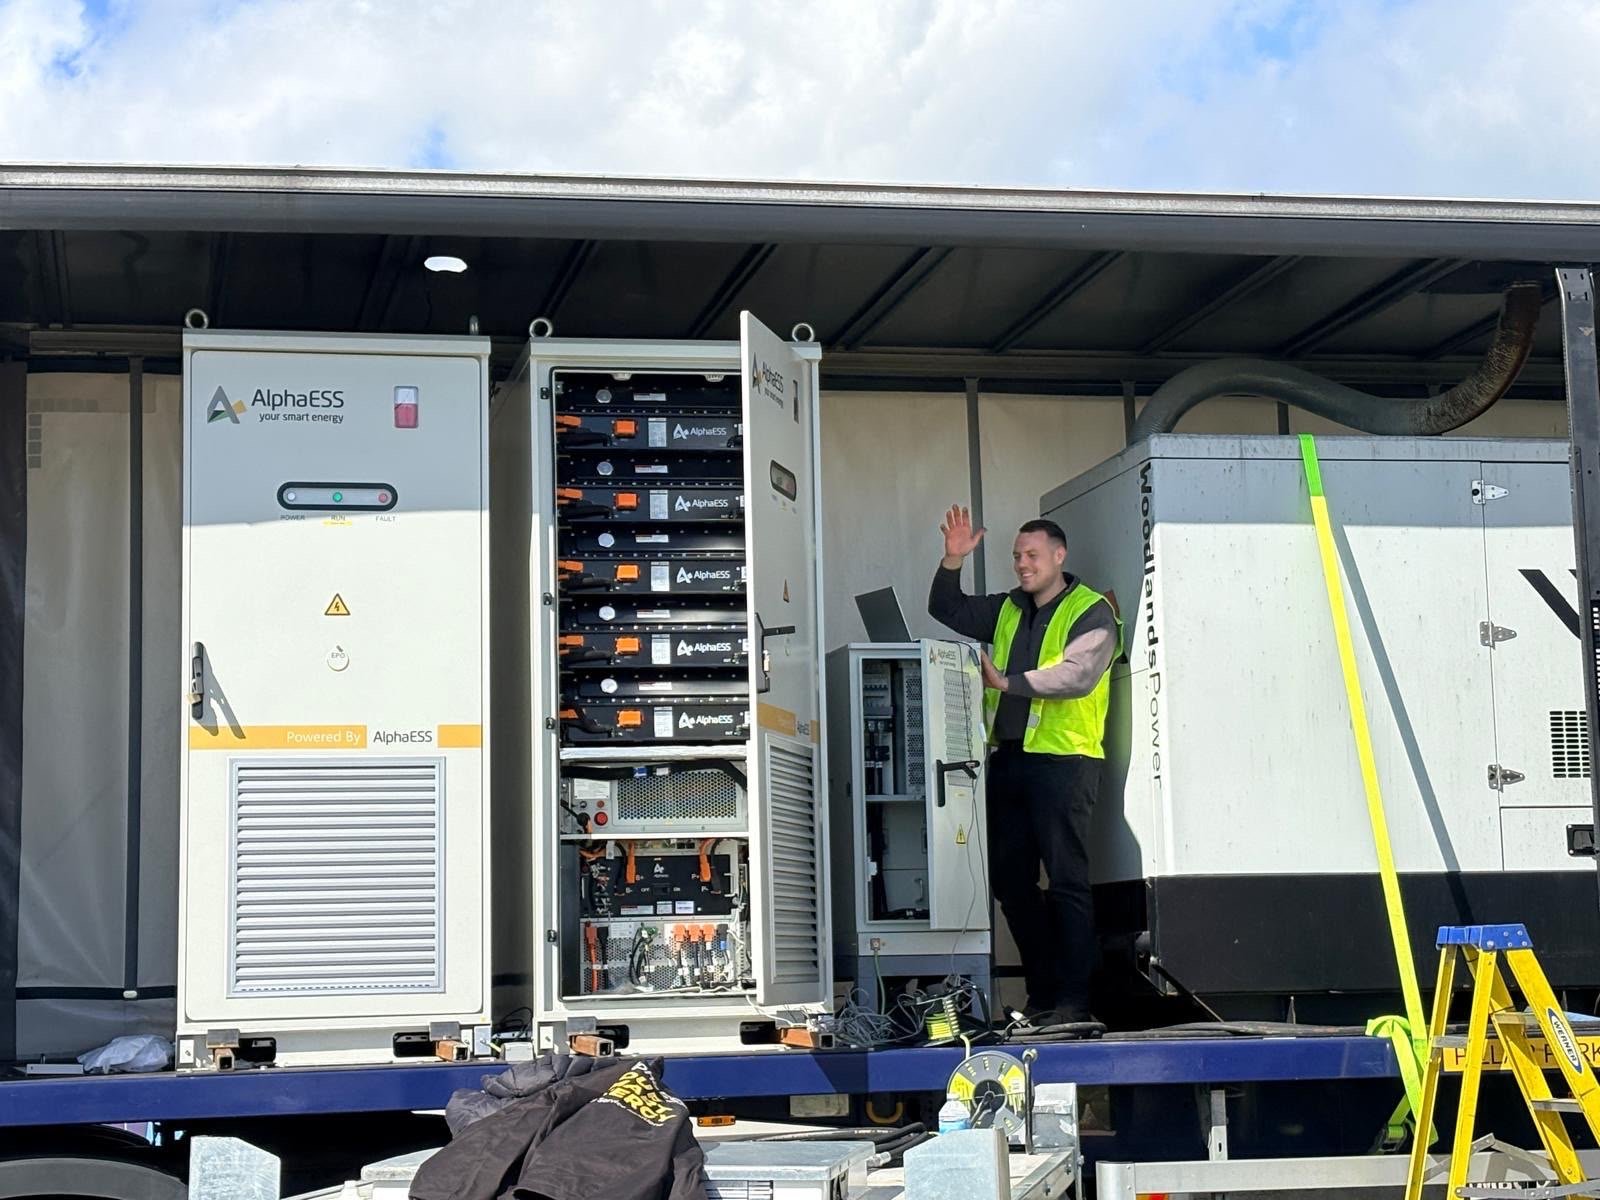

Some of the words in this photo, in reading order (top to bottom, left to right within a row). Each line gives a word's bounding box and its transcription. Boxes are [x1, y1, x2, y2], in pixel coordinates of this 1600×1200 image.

[251, 389, 344, 411] AlphaESS
[259, 413, 280, 423] your
[283, 412, 309, 421] smart
[311, 413, 344, 424] energy
[690, 427, 727, 437] AlphaESS
[691, 499, 729, 509] AlphaESS
[693, 570, 731, 581] AlphaESS
[693, 642, 732, 653] AlphaESS
[695, 714, 734, 726] AlphaESS
[286, 731, 342, 743] Powered
[345, 731, 361, 745] By
[373, 730, 433, 745] AlphaESS
[1553, 1020, 1577, 1062] WERNER
